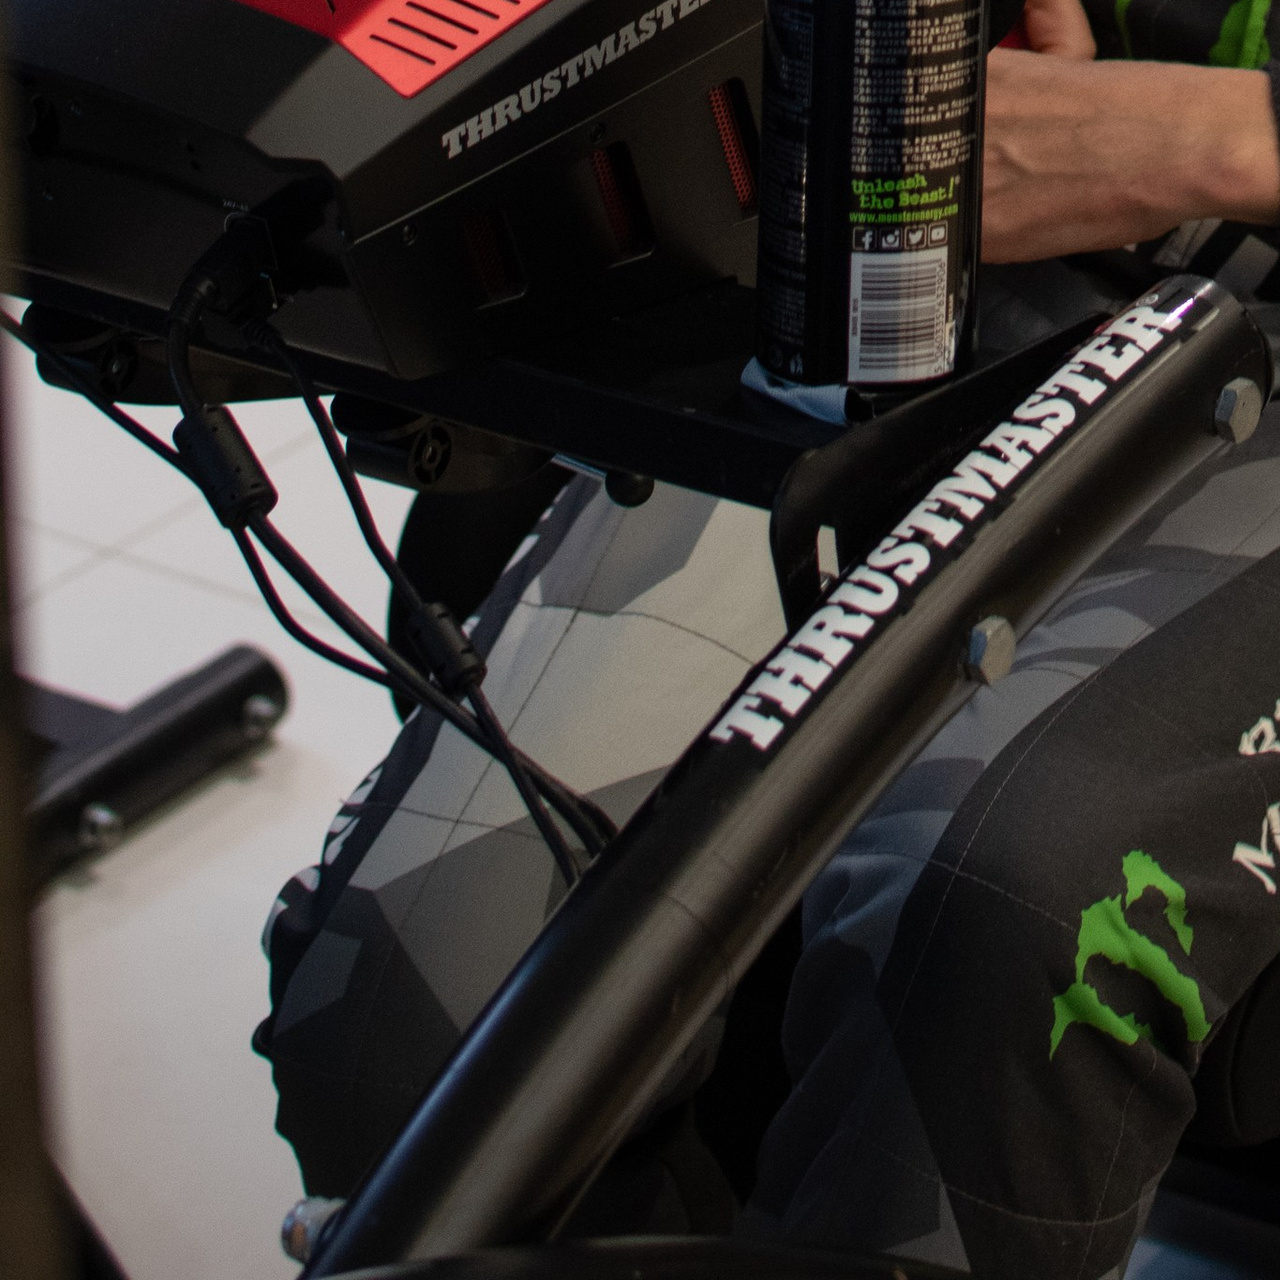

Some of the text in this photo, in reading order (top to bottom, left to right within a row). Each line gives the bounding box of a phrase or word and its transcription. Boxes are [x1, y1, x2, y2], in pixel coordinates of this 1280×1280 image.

[851, 171, 927, 195] Unleash
[861, 194, 895, 209] the
[849, 203, 958, 223] www.monsterenergy.com
[708, 303, 1183, 752] THRUSTMASTER
